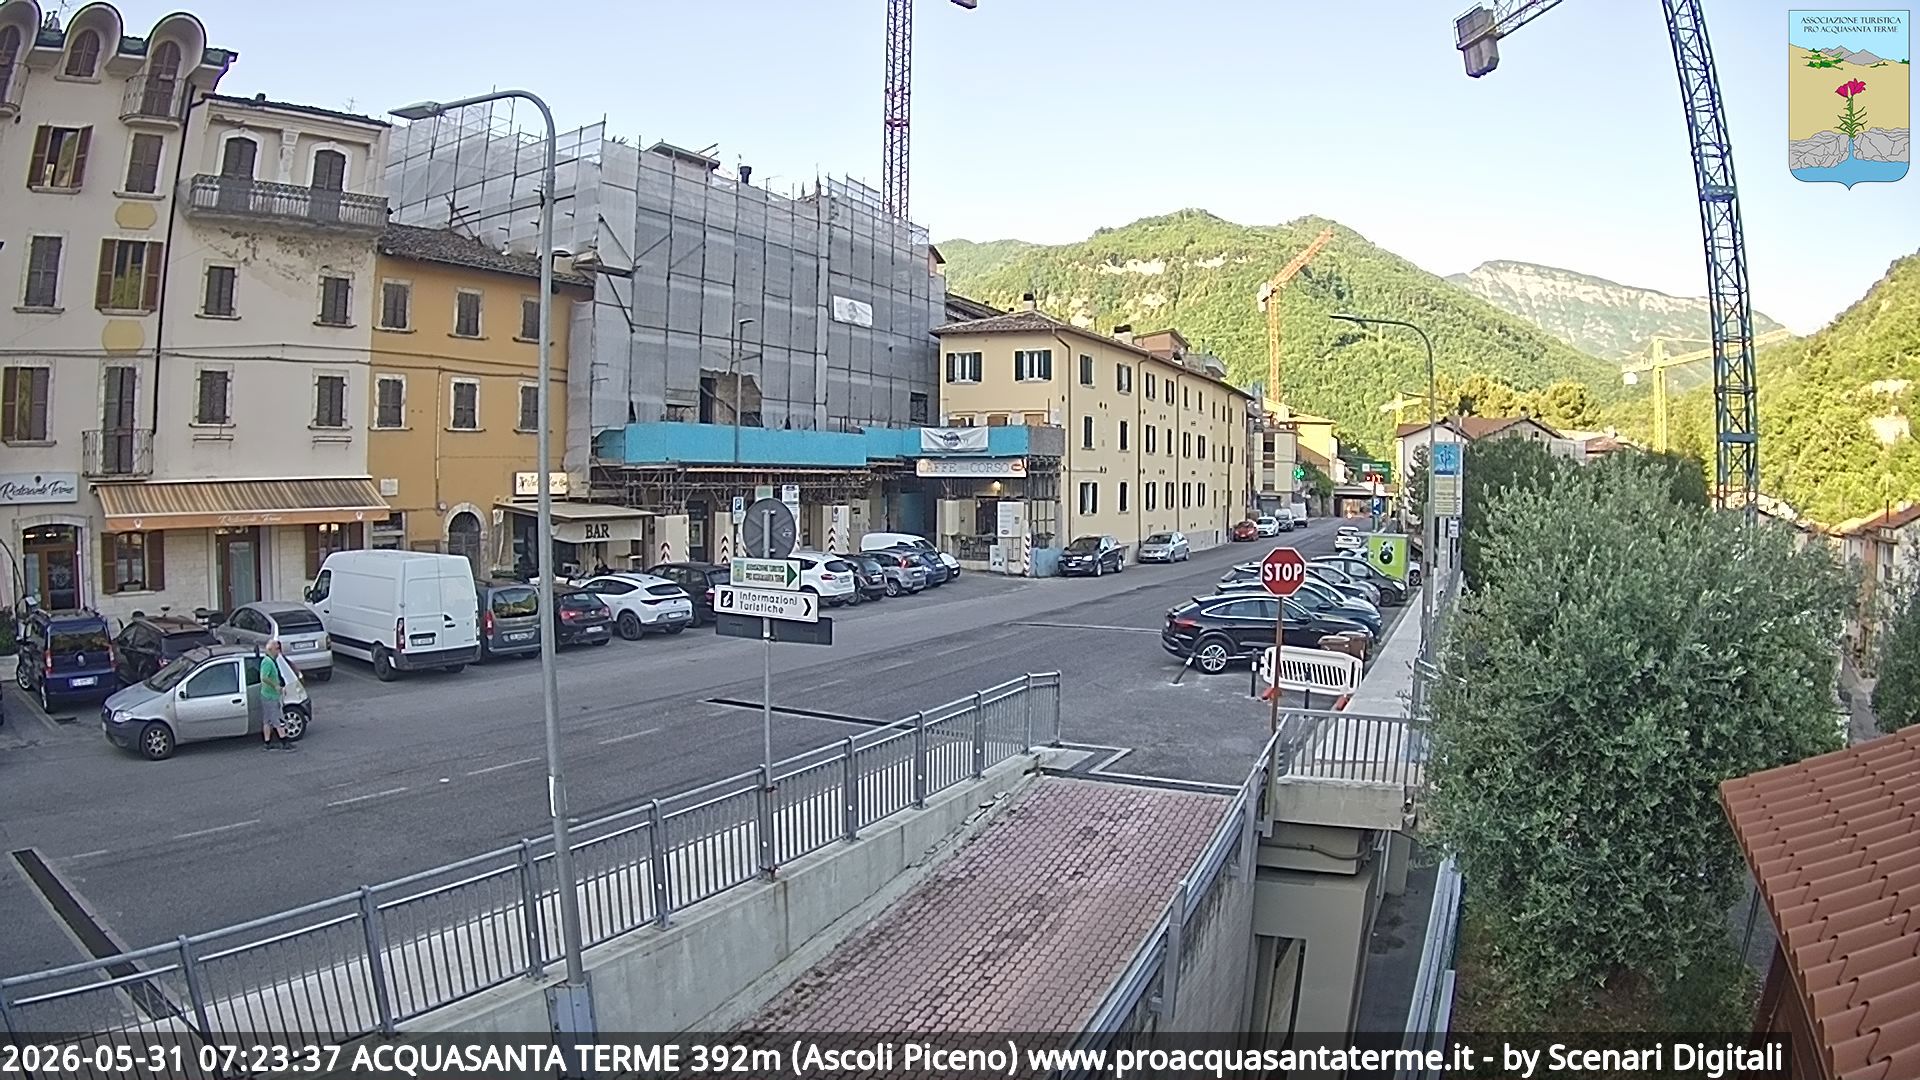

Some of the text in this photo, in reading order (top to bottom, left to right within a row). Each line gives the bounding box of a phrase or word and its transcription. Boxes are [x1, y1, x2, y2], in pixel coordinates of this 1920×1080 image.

[970, 462, 1009, 473] CORSO
[585, 523, 610, 539] BAR
[1264, 563, 1303, 581] STOP
[740, 591, 797, 606] Informazioni
[740, 601, 784, 614] Turistiche
